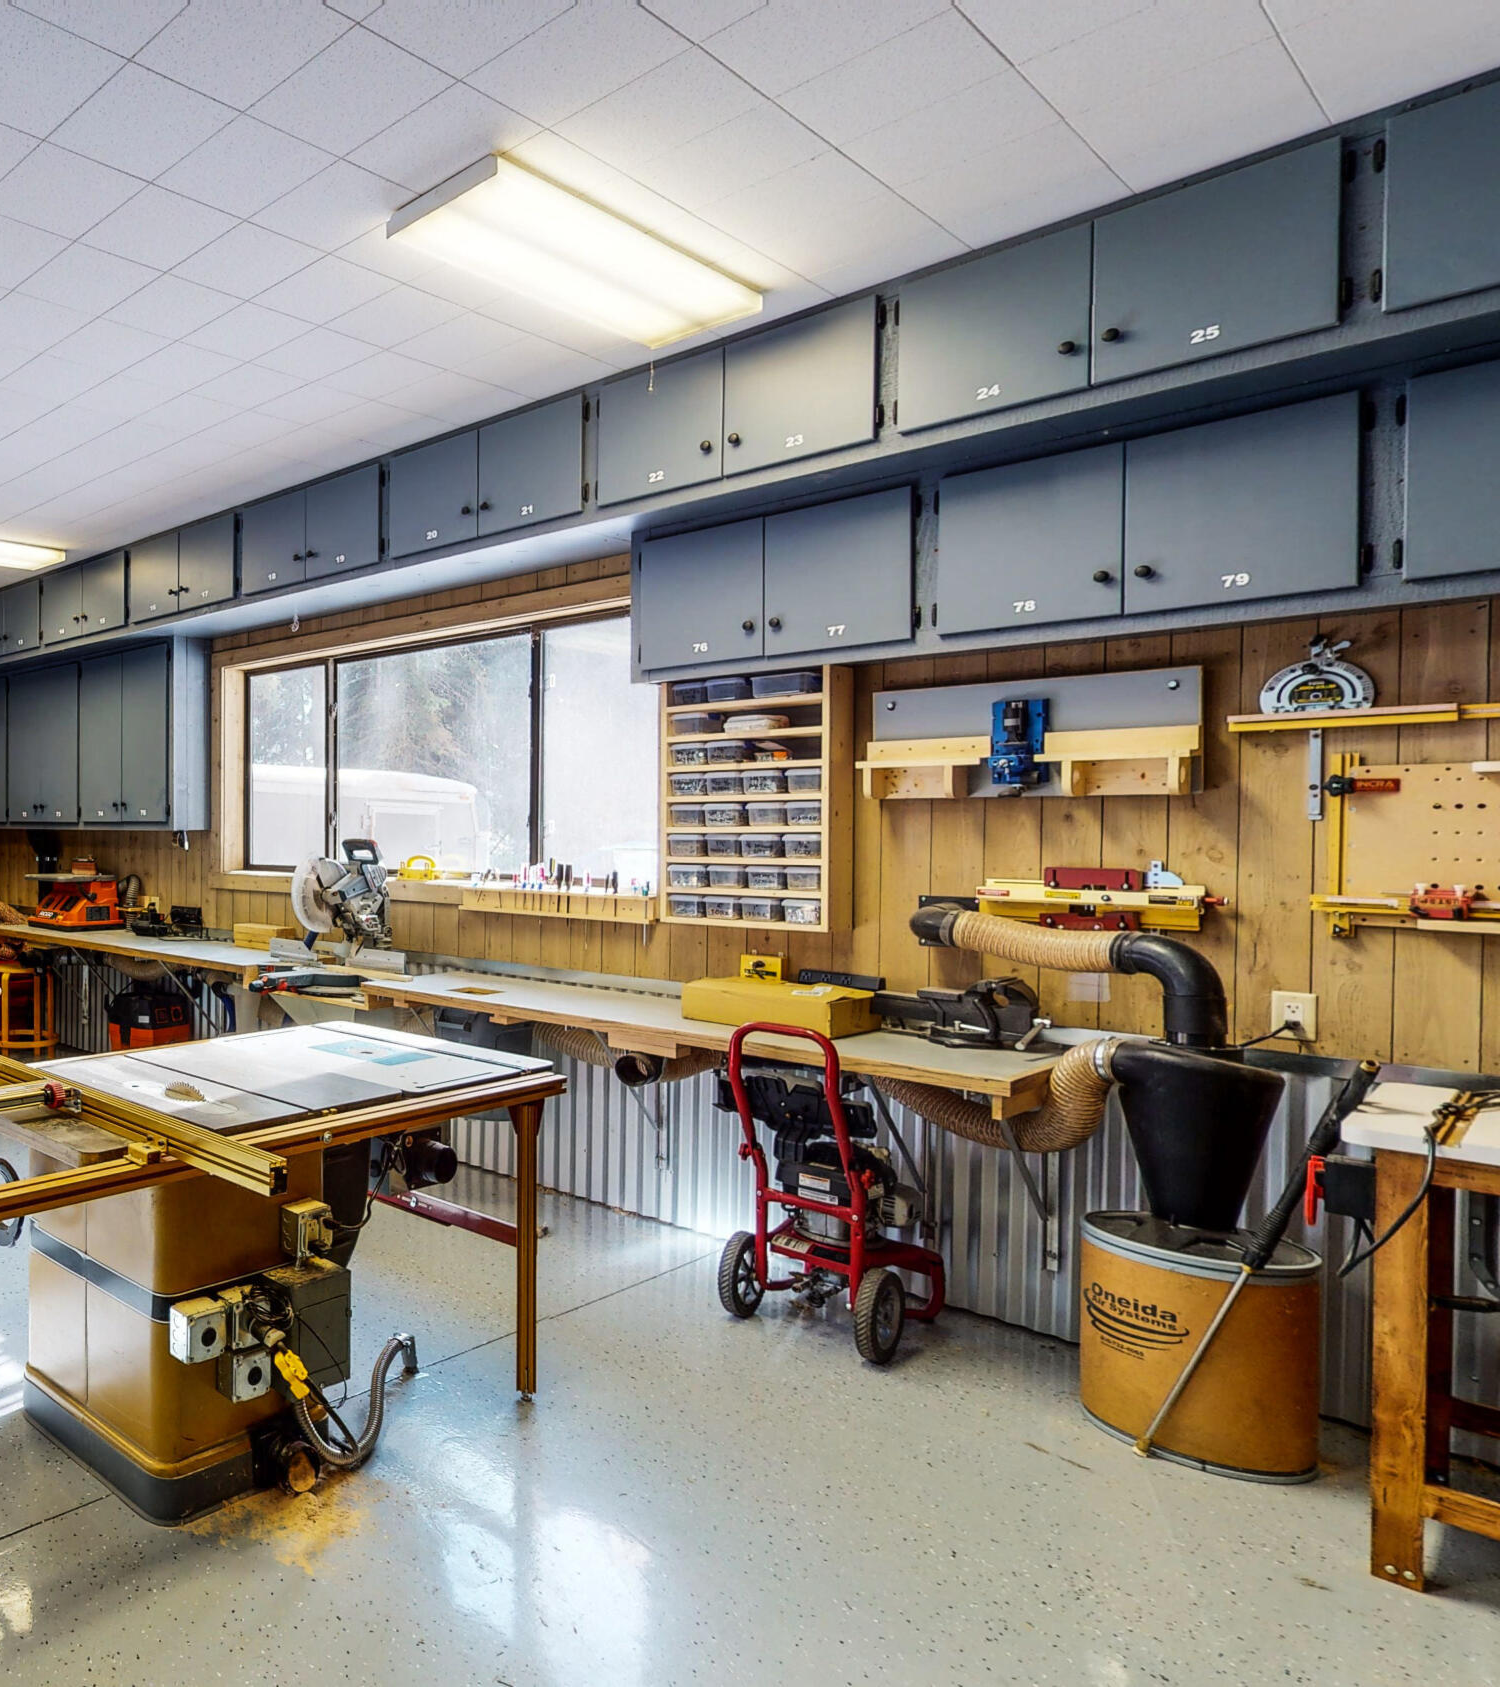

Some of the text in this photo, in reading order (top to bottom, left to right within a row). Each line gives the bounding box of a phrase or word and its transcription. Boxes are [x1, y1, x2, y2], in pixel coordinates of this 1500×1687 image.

[1191, 325, 1219, 344] 25
[977, 385, 999, 400] 24
[786, 435, 803, 447] 23
[649, 471, 664, 482] 22
[521, 504, 533, 516] 21
[426, 529, 438, 540] 20
[335, 554, 345, 564] 19
[267, 572, 277, 581] 18
[1222, 573, 1249, 587] 79
[1013, 600, 1035, 612] 78
[828, 625, 845, 636] 77
[693, 643, 707, 652] 76
[1355, 779, 1395, 789] INCRA
[1091, 1281, 1178, 1323] Oneida
[1091, 1294, 1178, 1331] Air Systems
